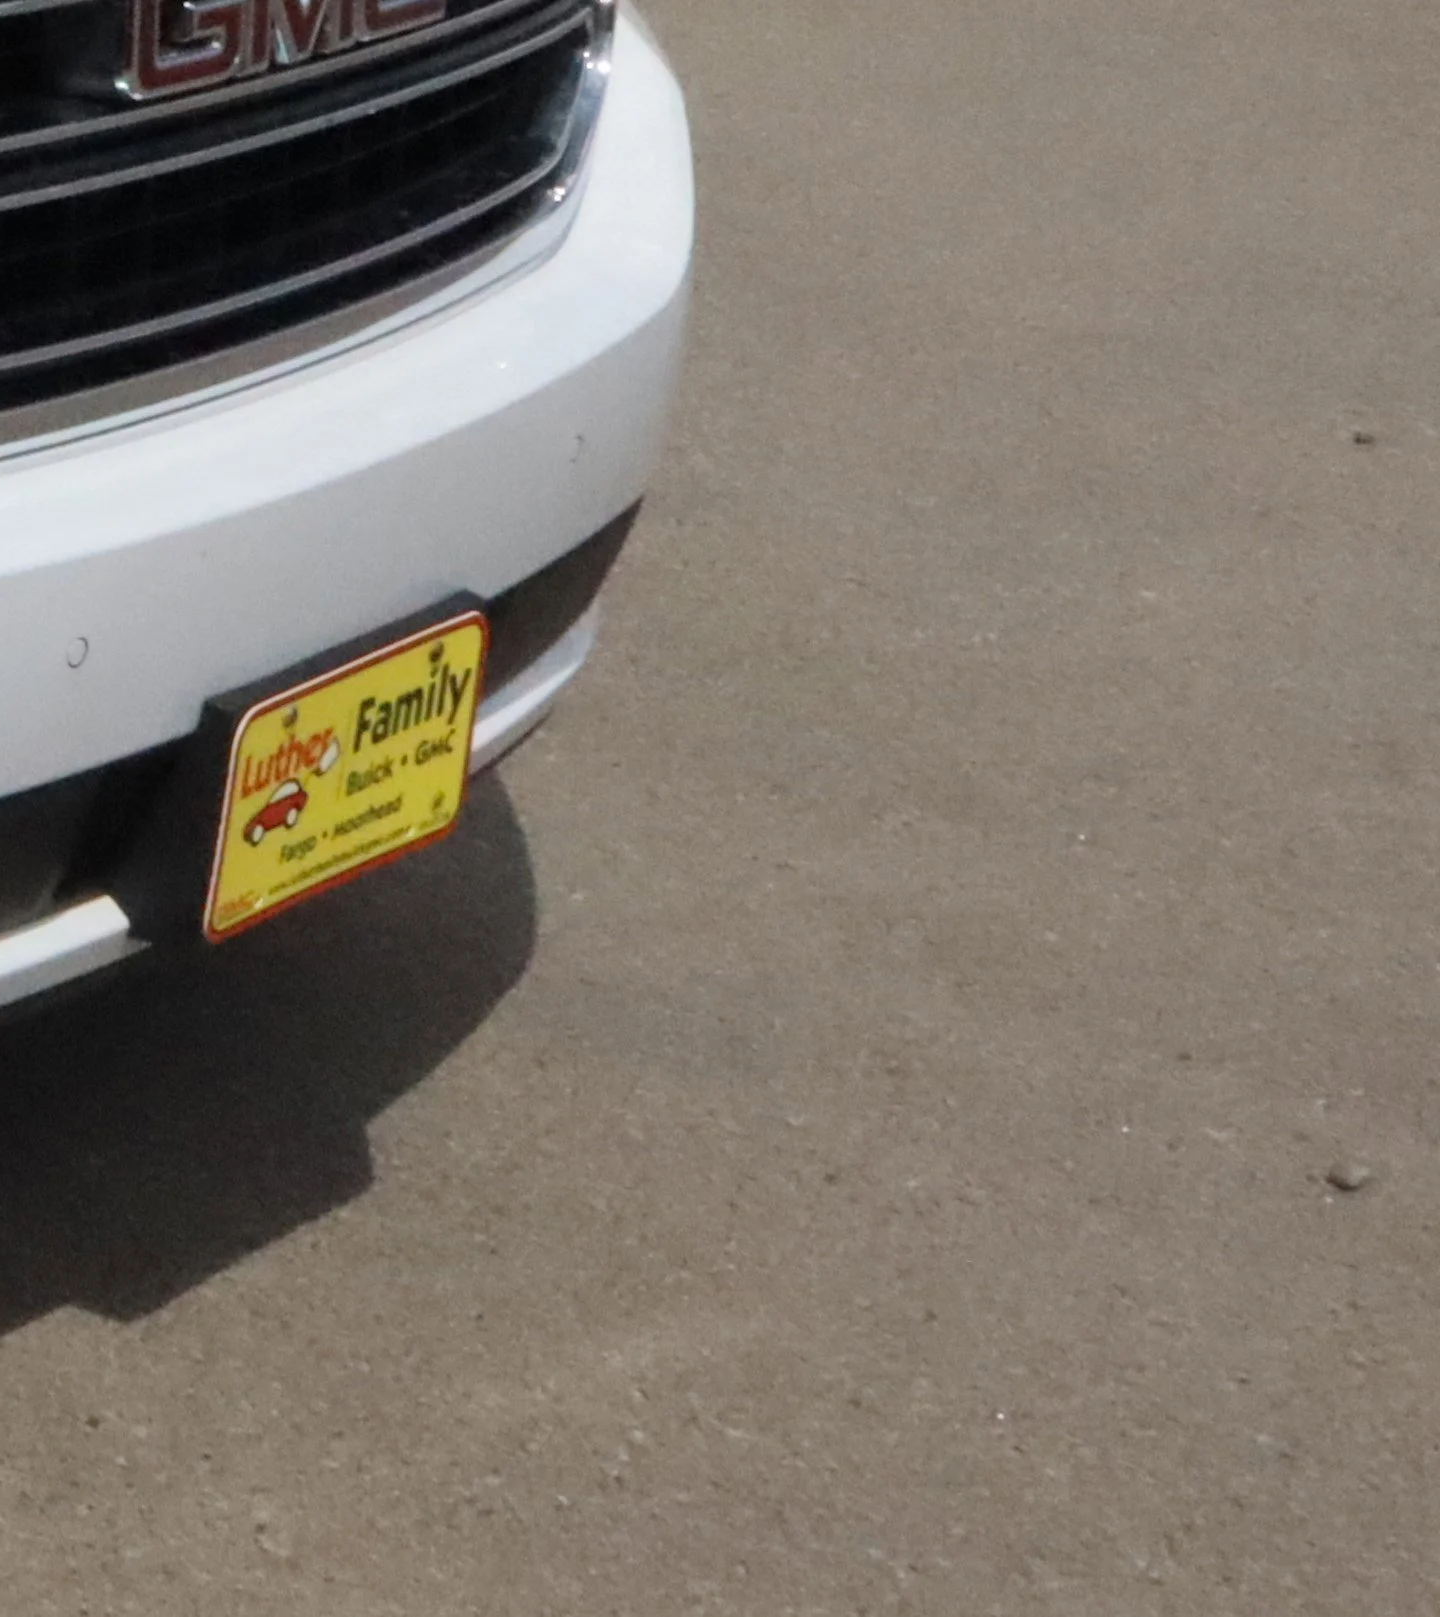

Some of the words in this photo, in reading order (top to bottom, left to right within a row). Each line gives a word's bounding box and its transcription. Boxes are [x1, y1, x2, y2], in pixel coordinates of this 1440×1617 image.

[352, 663, 471, 754] Family
[241, 726, 334, 798] Luther
[346, 756, 394, 796] Buick
